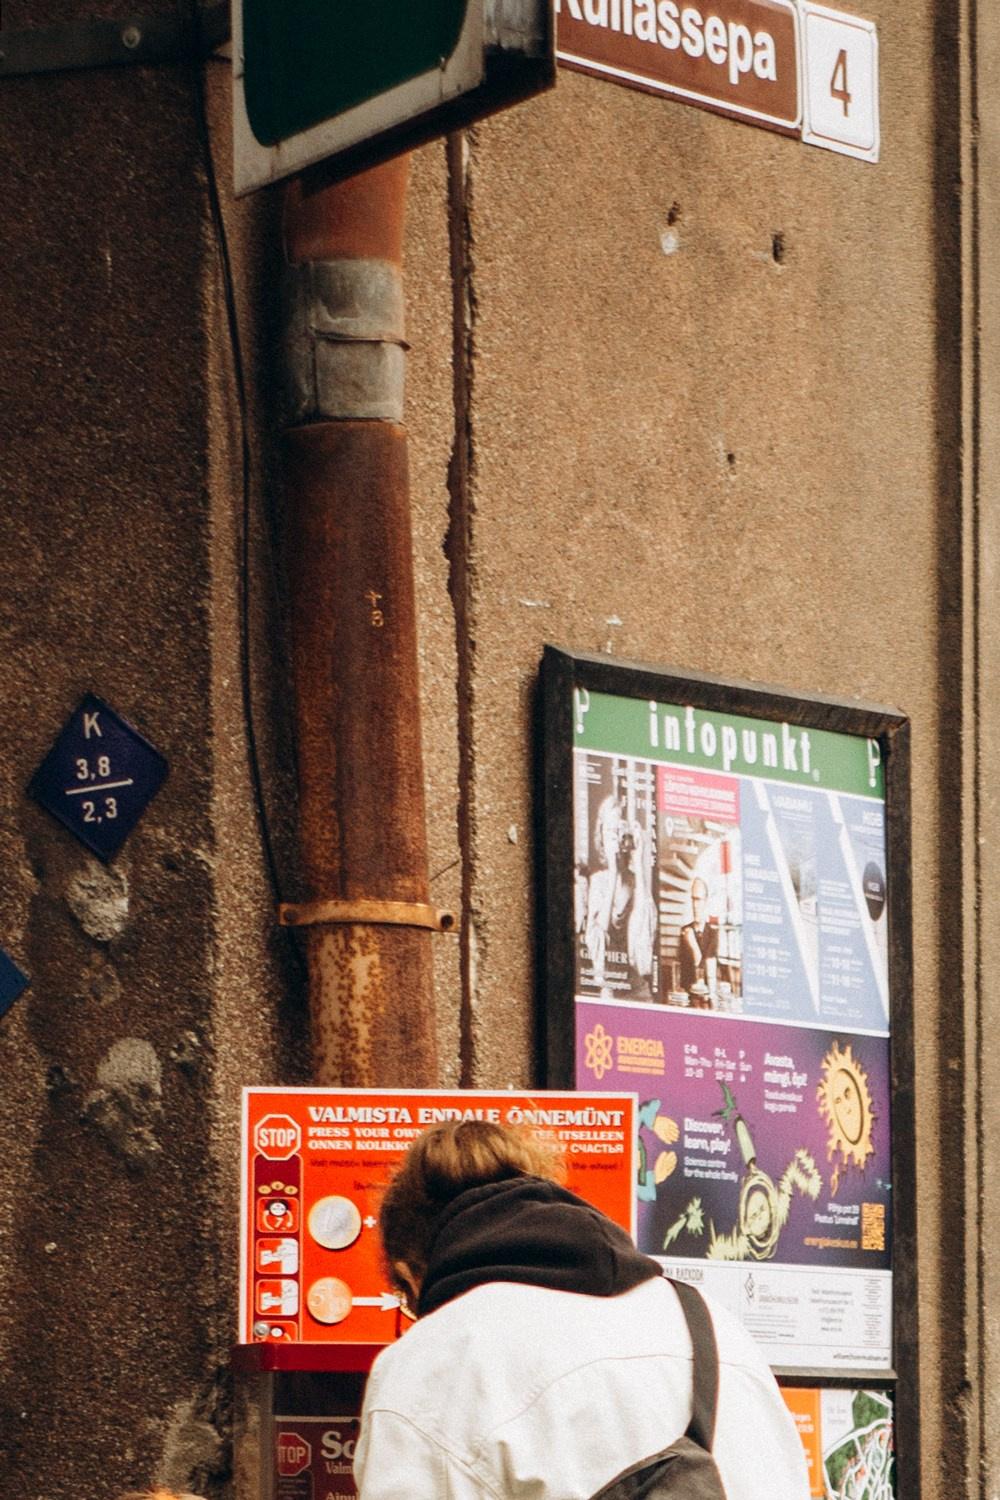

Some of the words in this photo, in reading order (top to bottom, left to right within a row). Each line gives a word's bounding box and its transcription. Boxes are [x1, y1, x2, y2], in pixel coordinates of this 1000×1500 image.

[554, 0, 777, 85] ullassepa
[830, 49, 852, 117] 4
[83, 712, 102, 739] K
[617, 1036, 665, 1058] ENERGIA
[308, 1106, 413, 1124] VALMISTA
[506, 1106, 625, 1126] ÕNNEMÜNT
[259, 1128, 296, 1147] STOP
[308, 1126, 349, 1137] PRESS
[354, 1127, 390, 1138] YOUR
[558, 1130, 624, 1141] ITSELLEEN
[308, 1140, 352, 1150] ONNEN
[278, 1446, 306, 1463] TOP
